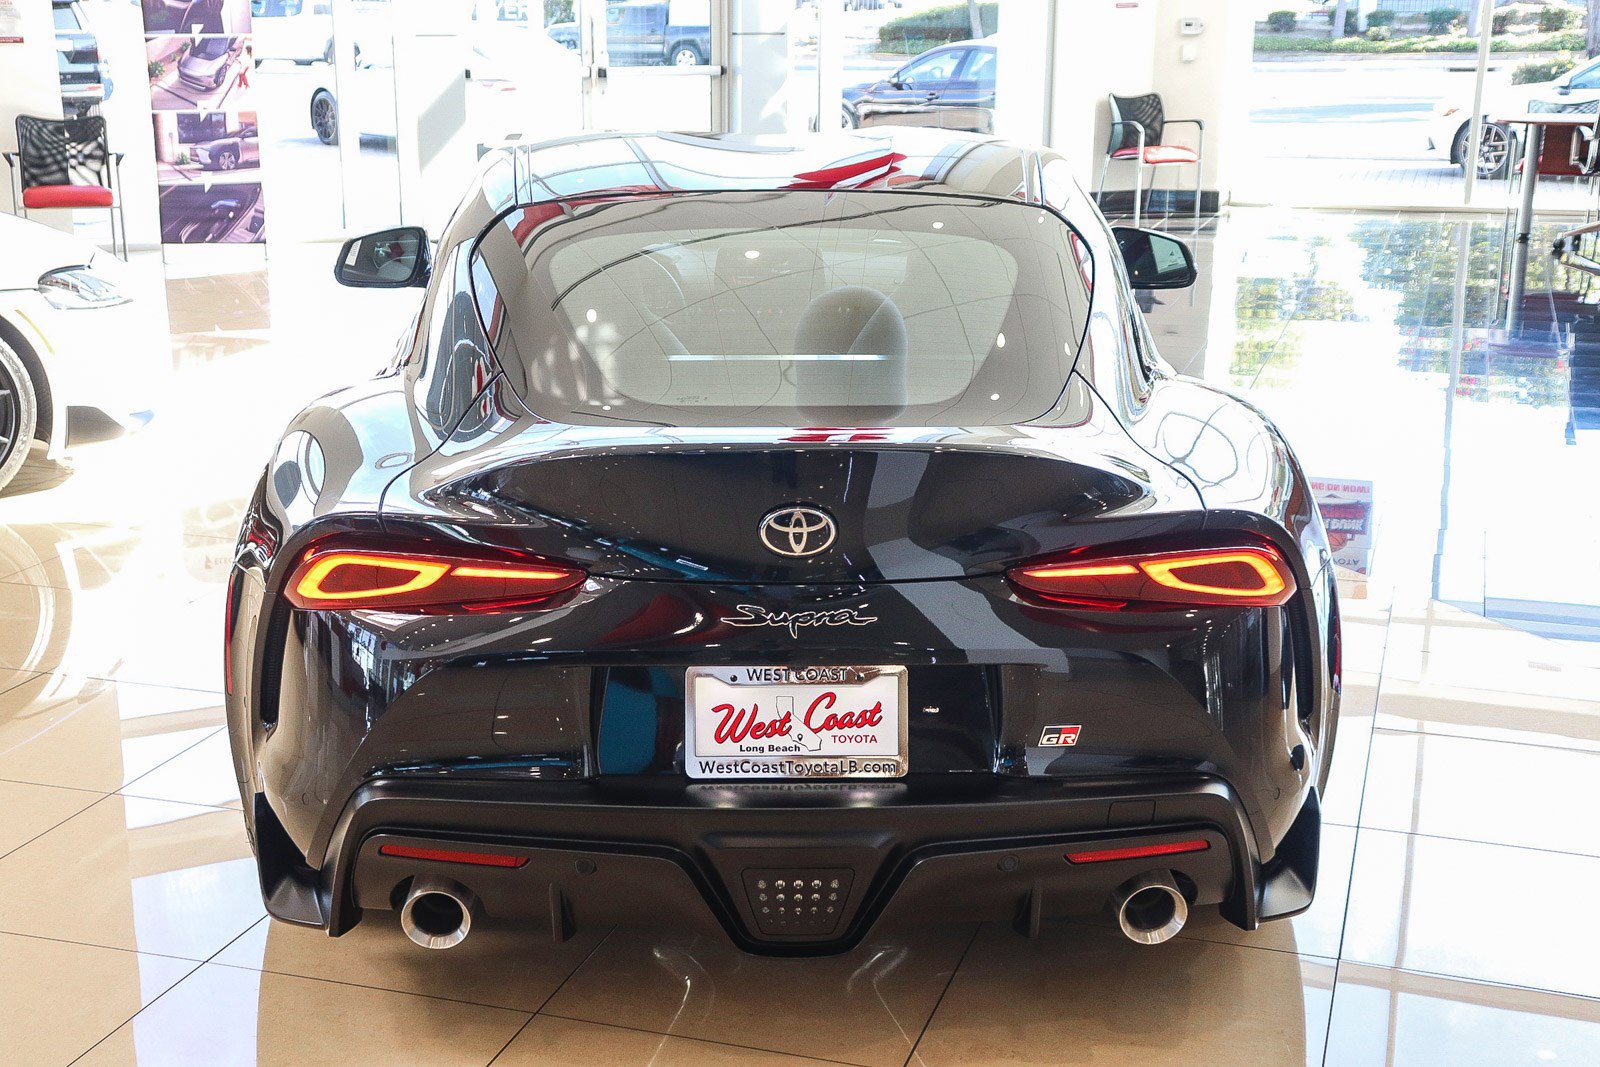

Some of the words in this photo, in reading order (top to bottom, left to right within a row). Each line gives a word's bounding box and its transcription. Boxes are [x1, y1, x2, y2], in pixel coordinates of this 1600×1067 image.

[721, 604, 878, 639] Supra
[746, 668, 791, 682] WEST
[795, 668, 848, 682] COAST
[711, 703, 793, 744] West
[804, 691, 883, 734] Coast
[831, 735, 878, 744] TOYOTA
[1041, 734, 1077, 745] GR
[739, 744, 765, 754] Long
[768, 744, 801, 753] Beach
[699, 760, 897, 776] WestCoastToyotaLB.com
